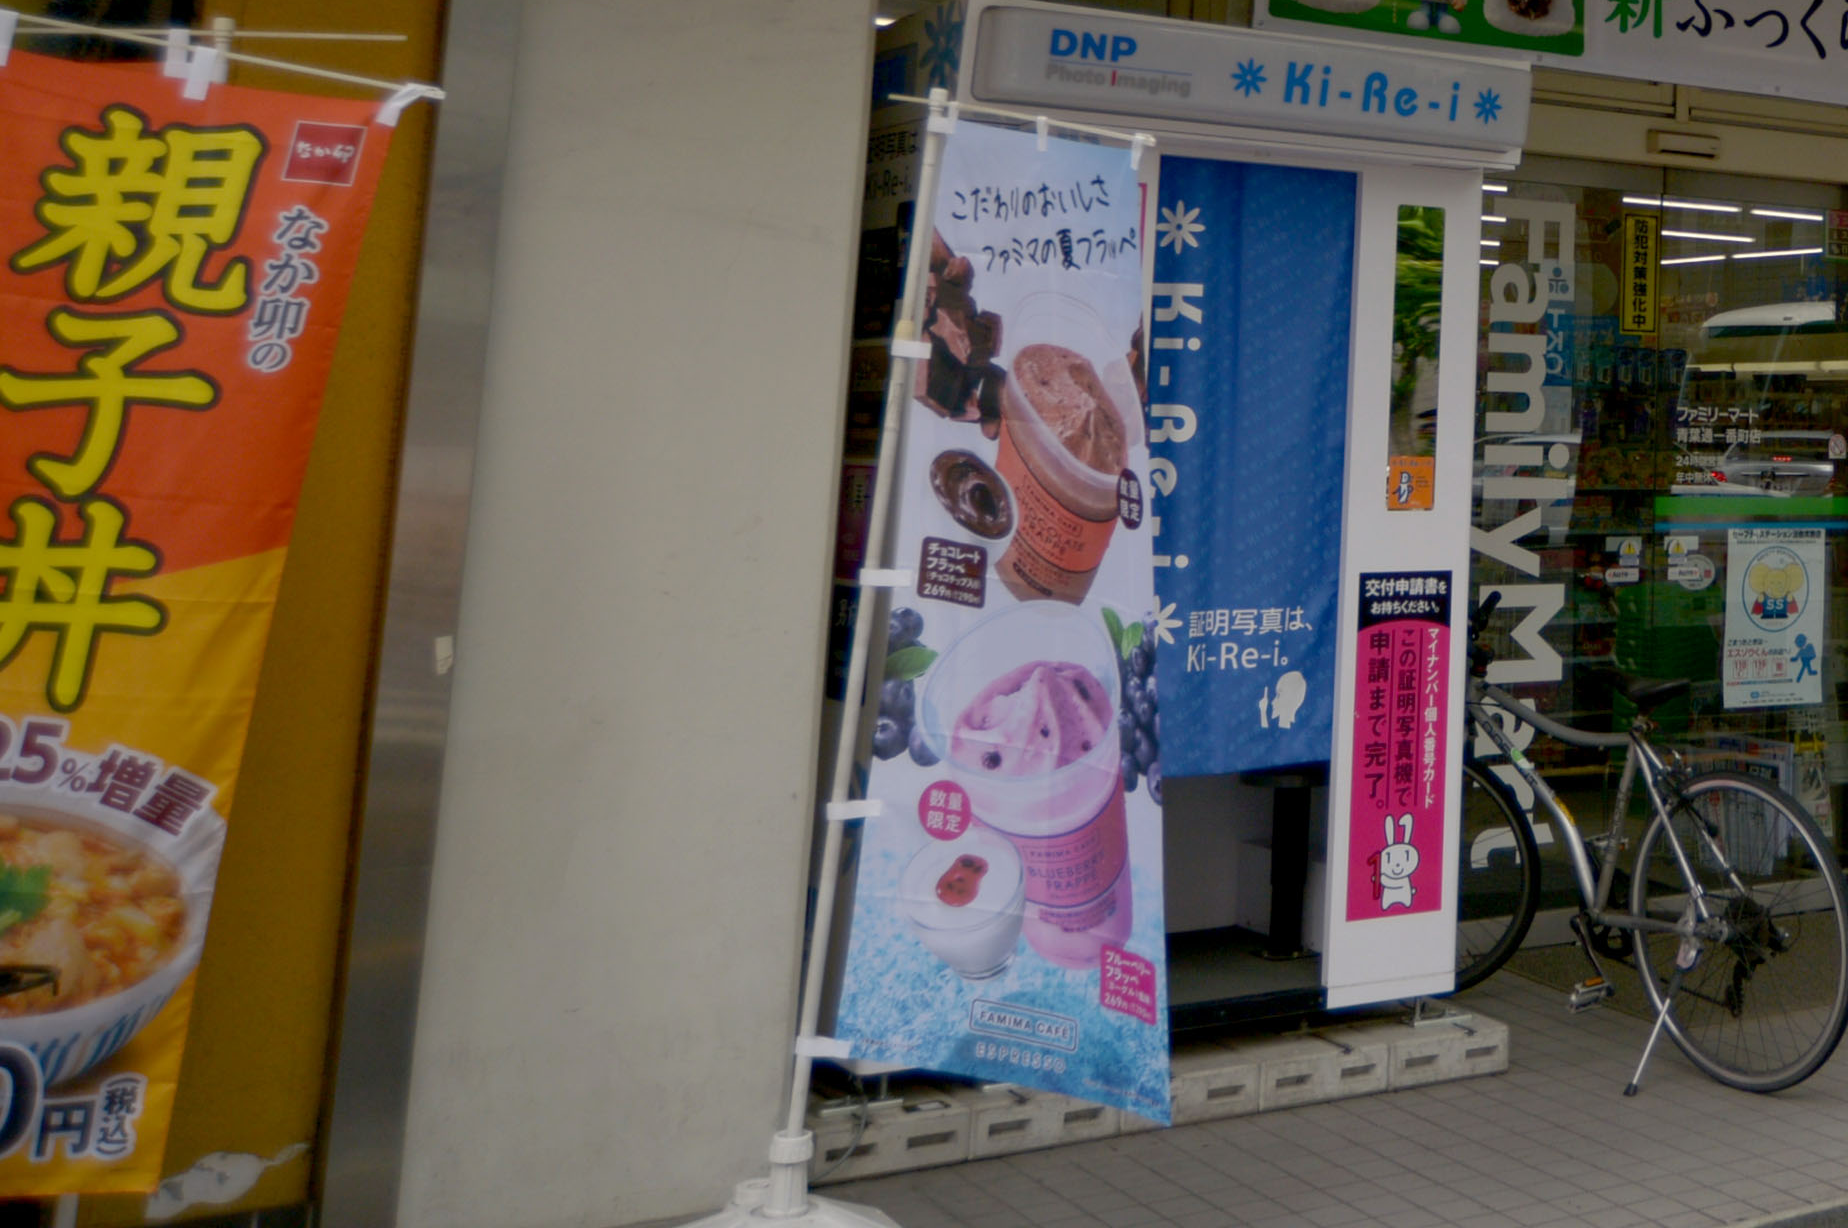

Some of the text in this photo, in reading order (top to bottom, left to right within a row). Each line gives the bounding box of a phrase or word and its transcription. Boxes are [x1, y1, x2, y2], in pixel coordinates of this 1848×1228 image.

[1049, 29, 1138, 63] DNP
[1045, 61, 1106, 87] Photo
[1283, 61, 1461, 122] Ki-Re-i
[951, 175, 1110, 223] こだわりのおいしさ
[249, 205, 328, 372] なか卯の
[0, 102, 270, 712] 親子丼
[1676, 406, 1760, 425] ファミリーマート
[1365, 576, 1448, 597] 交付申請書を
[1189, 607, 1314, 638] 証明写真は、
[1364, 629, 1391, 810] 申請まで完了。
[0, 720, 211, 836] 5%増量
[928, 789, 963, 812] 数量
[926, 809, 962, 834] 限定
[979, 1009, 1033, 1031] FAMIMA
[975, 1040, 1067, 1075] ESPRESSO
